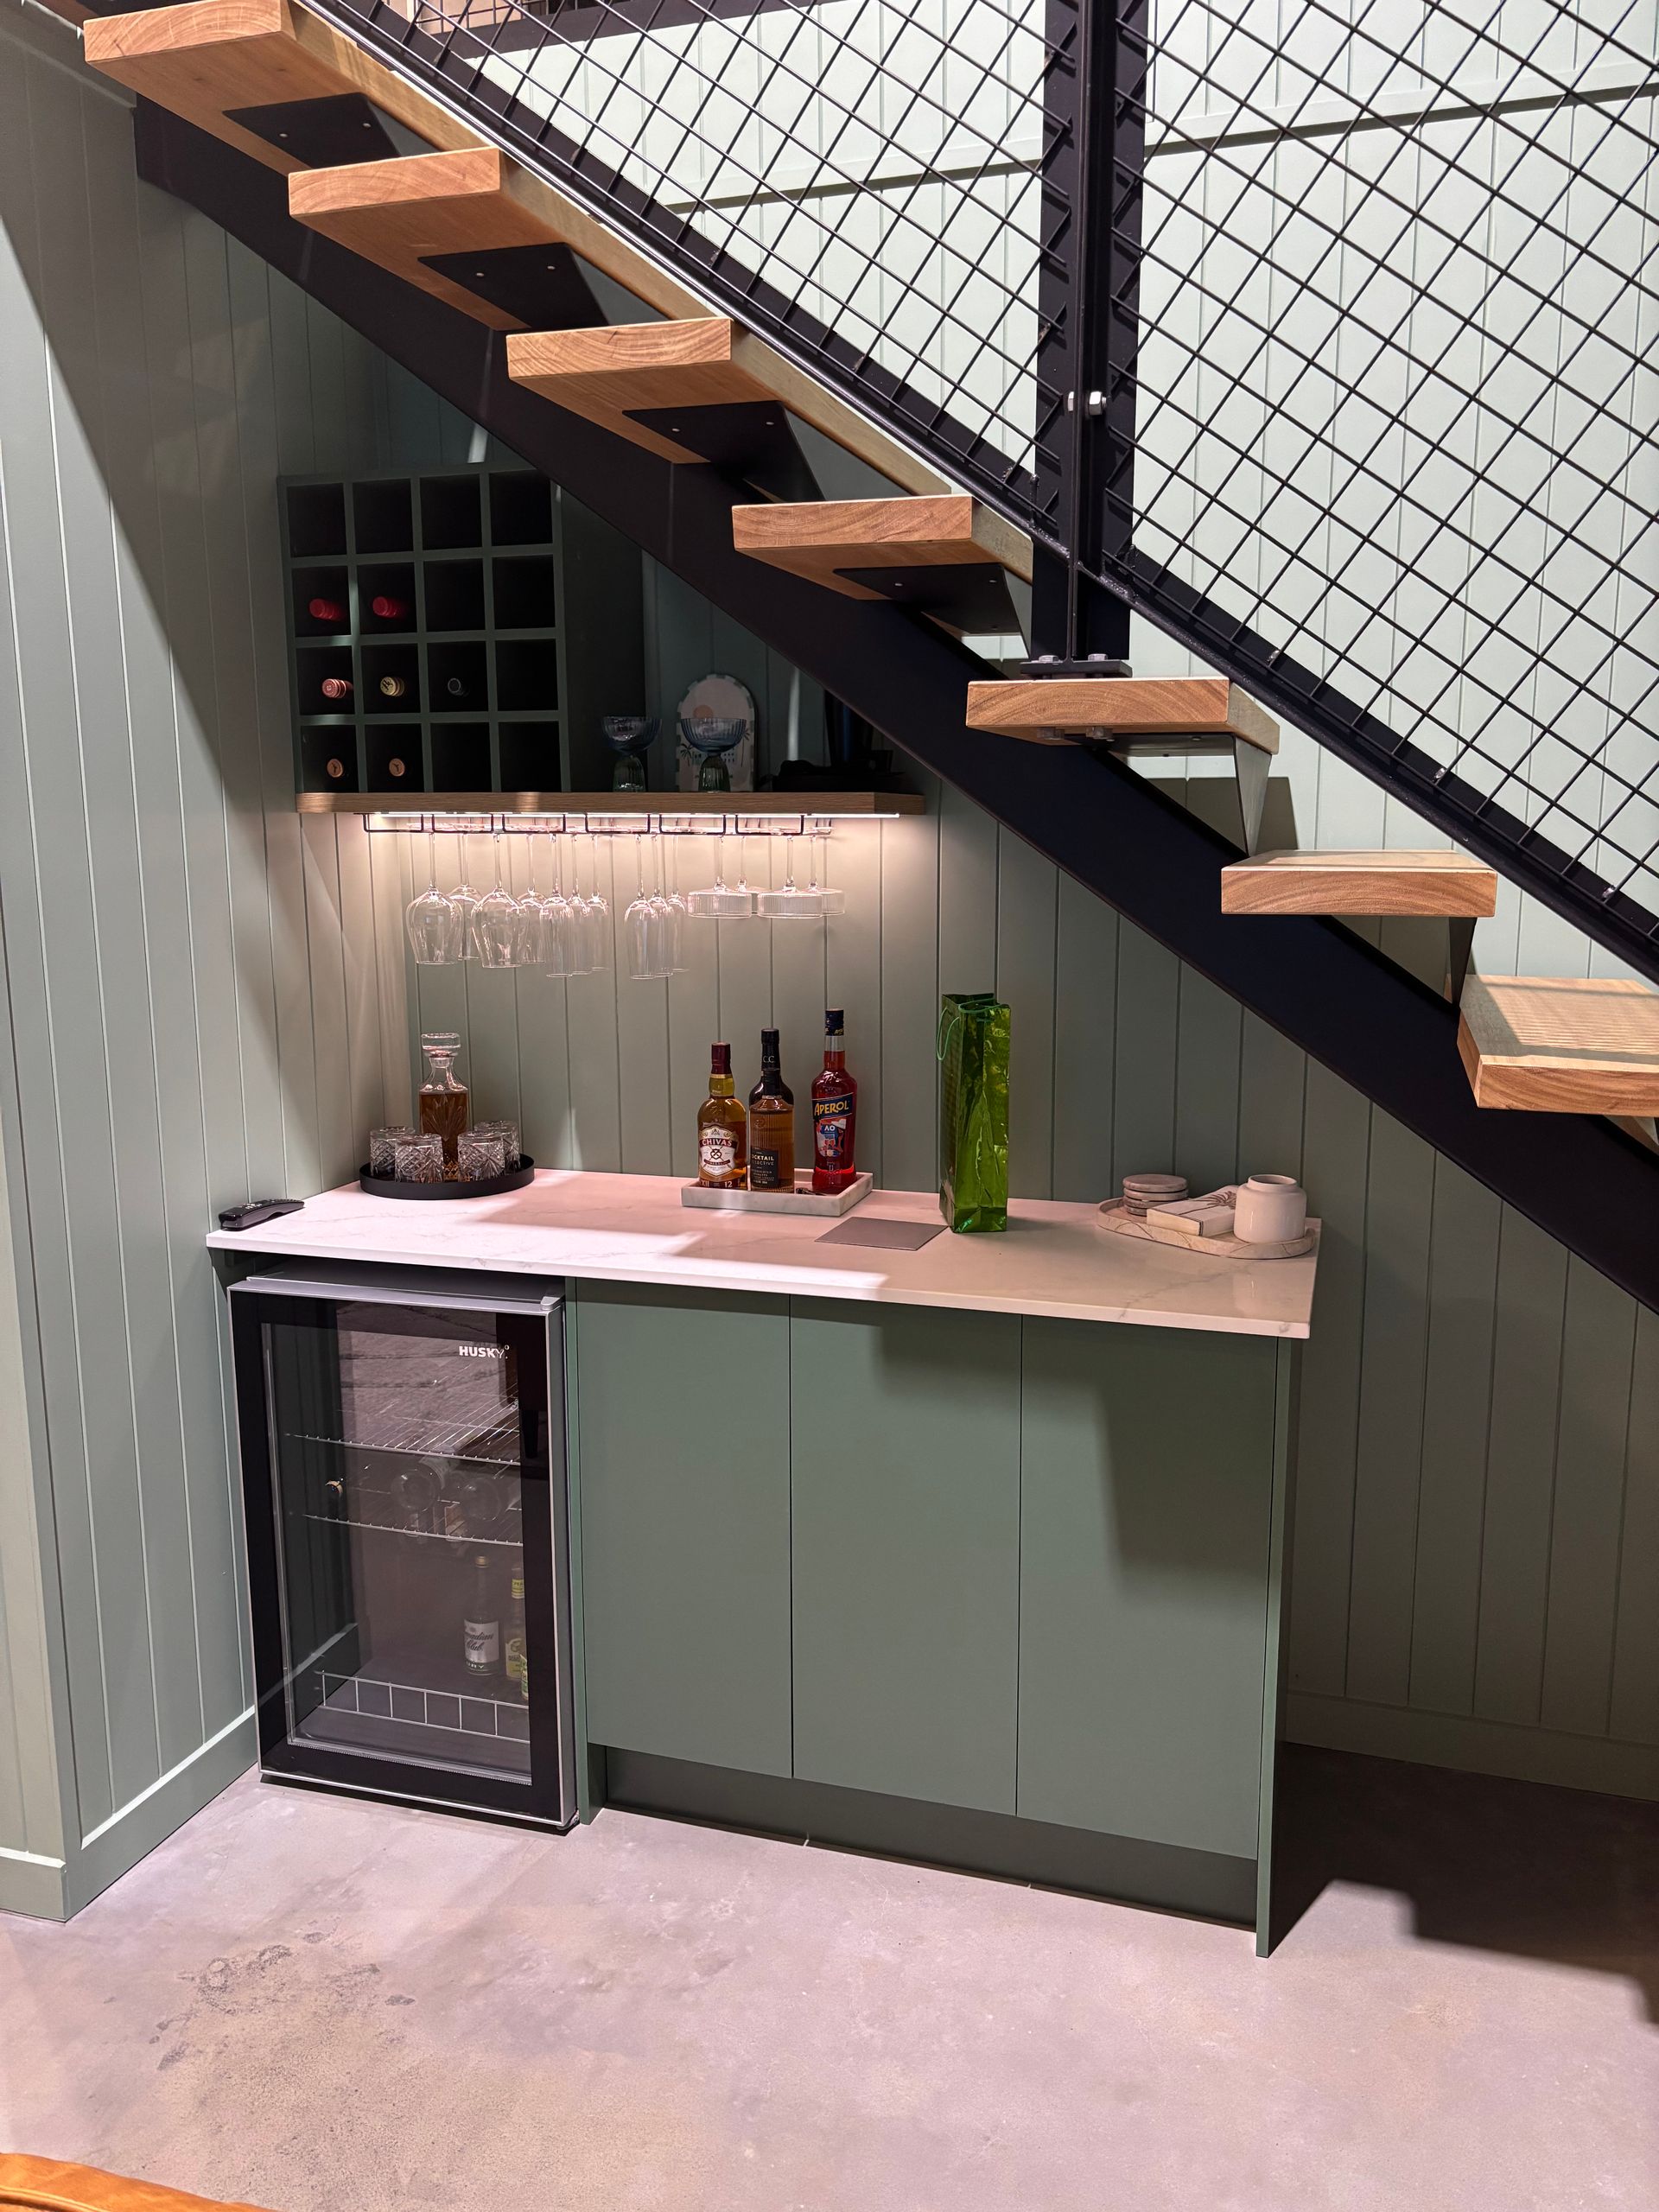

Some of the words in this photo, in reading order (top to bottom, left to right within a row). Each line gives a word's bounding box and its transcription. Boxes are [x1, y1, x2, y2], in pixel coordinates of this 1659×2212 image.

[814, 1100, 849, 1116] APEROL
[702, 1138, 733, 1147] CHIVAS
[459, 1345, 505, 1359] HUSKY
